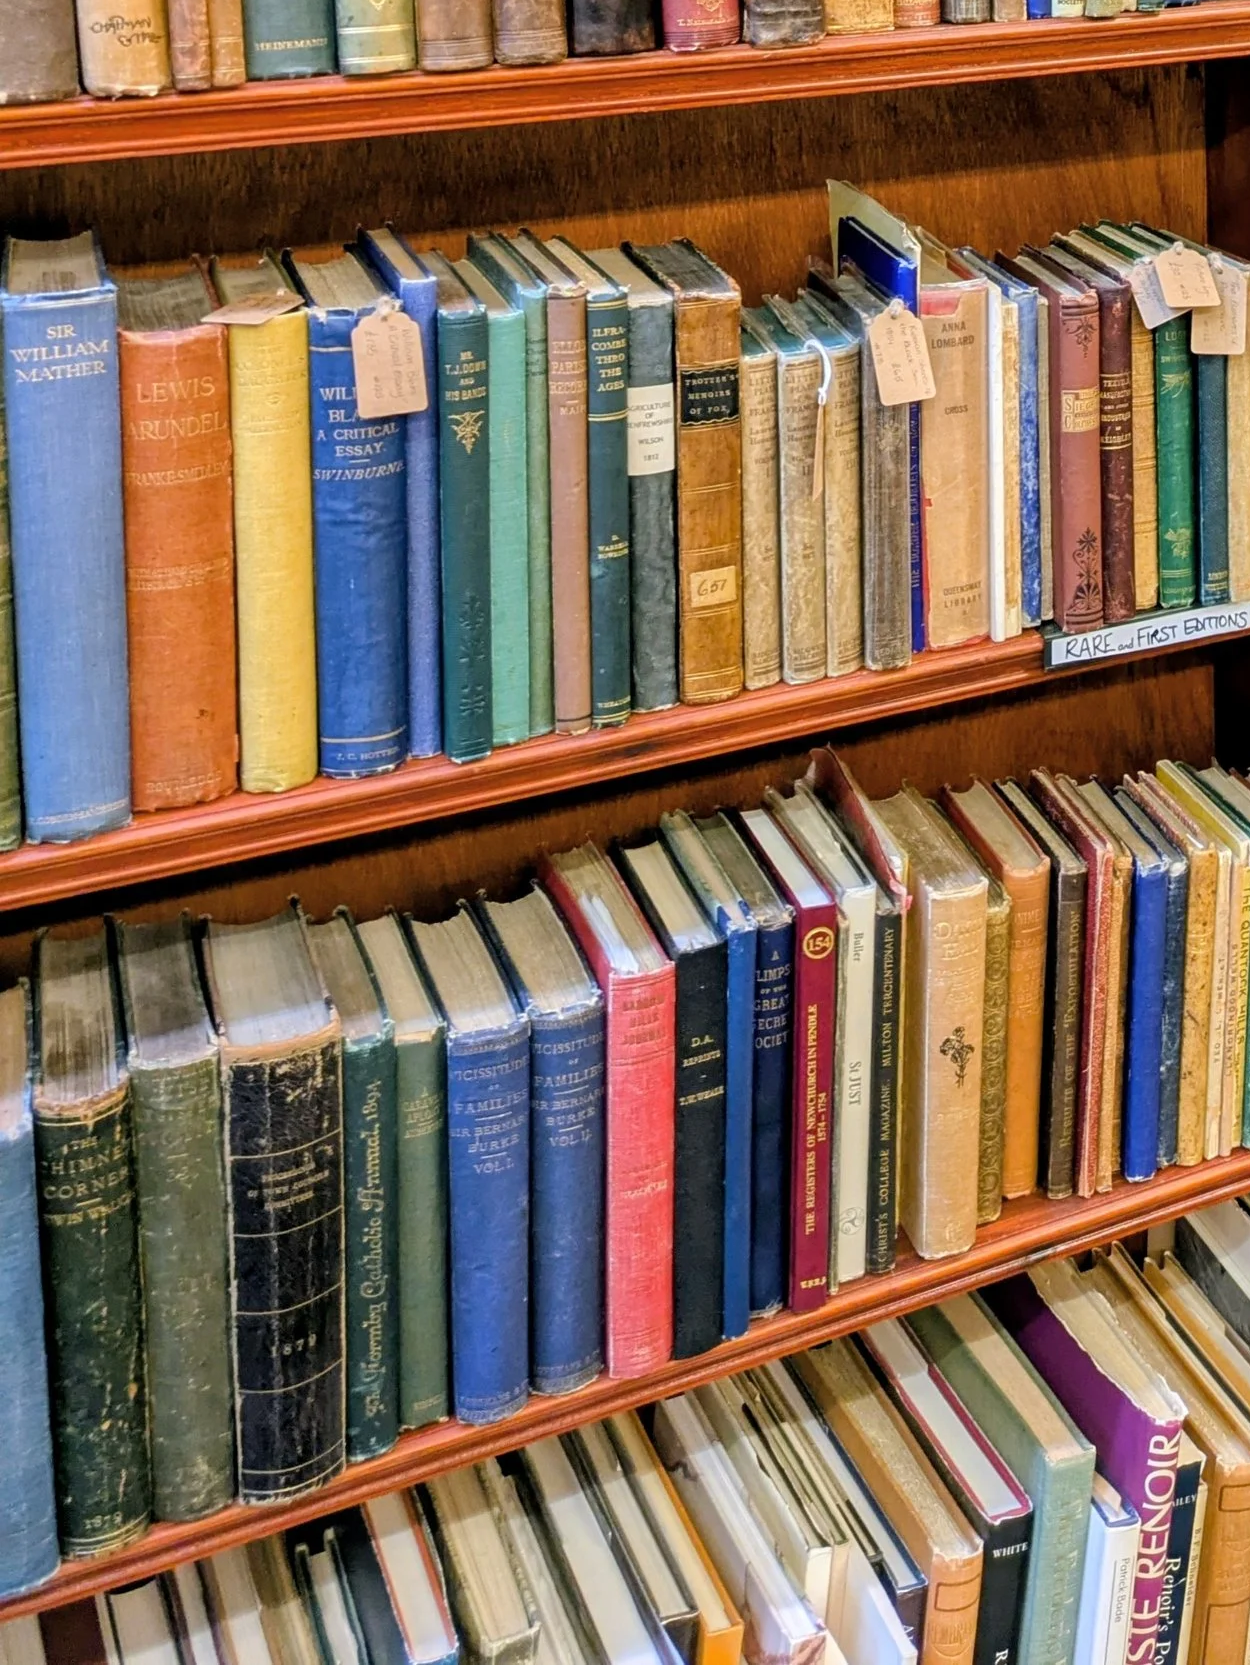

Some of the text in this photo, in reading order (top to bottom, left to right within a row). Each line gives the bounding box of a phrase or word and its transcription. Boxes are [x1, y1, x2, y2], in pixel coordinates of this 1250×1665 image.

[46, 325, 76, 340] SIR
[941, 322, 967, 333] ANNA
[11, 340, 109, 362] WILLIAM
[930, 335, 975, 350] LOMBARD
[15, 360, 107, 383] MATHER
[600, 369, 621, 379] THE
[136, 376, 215, 404] LEWIS
[597, 381, 626, 391] AGES
[127, 410, 228, 443] ARUNDEL
[317, 422, 399, 441] A CRITICAL
[1065, 612, 1248, 660] RARE and FIRST EDITIONS
[806, 933, 830, 955] 154
[853, 933, 864, 963] Buller
[883, 927, 894, 1015] TERCENTENARY
[808, 1004, 819, 1045] PENDLE
[882, 1021, 892, 1066] MILTON
[807, 1061, 818, 1129] NEWCHURCH
[805, 1151, 817, 1208] REGISTERS
[879, 1149, 890, 1207] COLLEGE
[805, 1208, 816, 1235] THE
[877, 1212, 889, 1272] CHRIST'S
[1136, 1434, 1178, 1575] RENOIR
[993, 1540, 1028, 1559] WHITE
